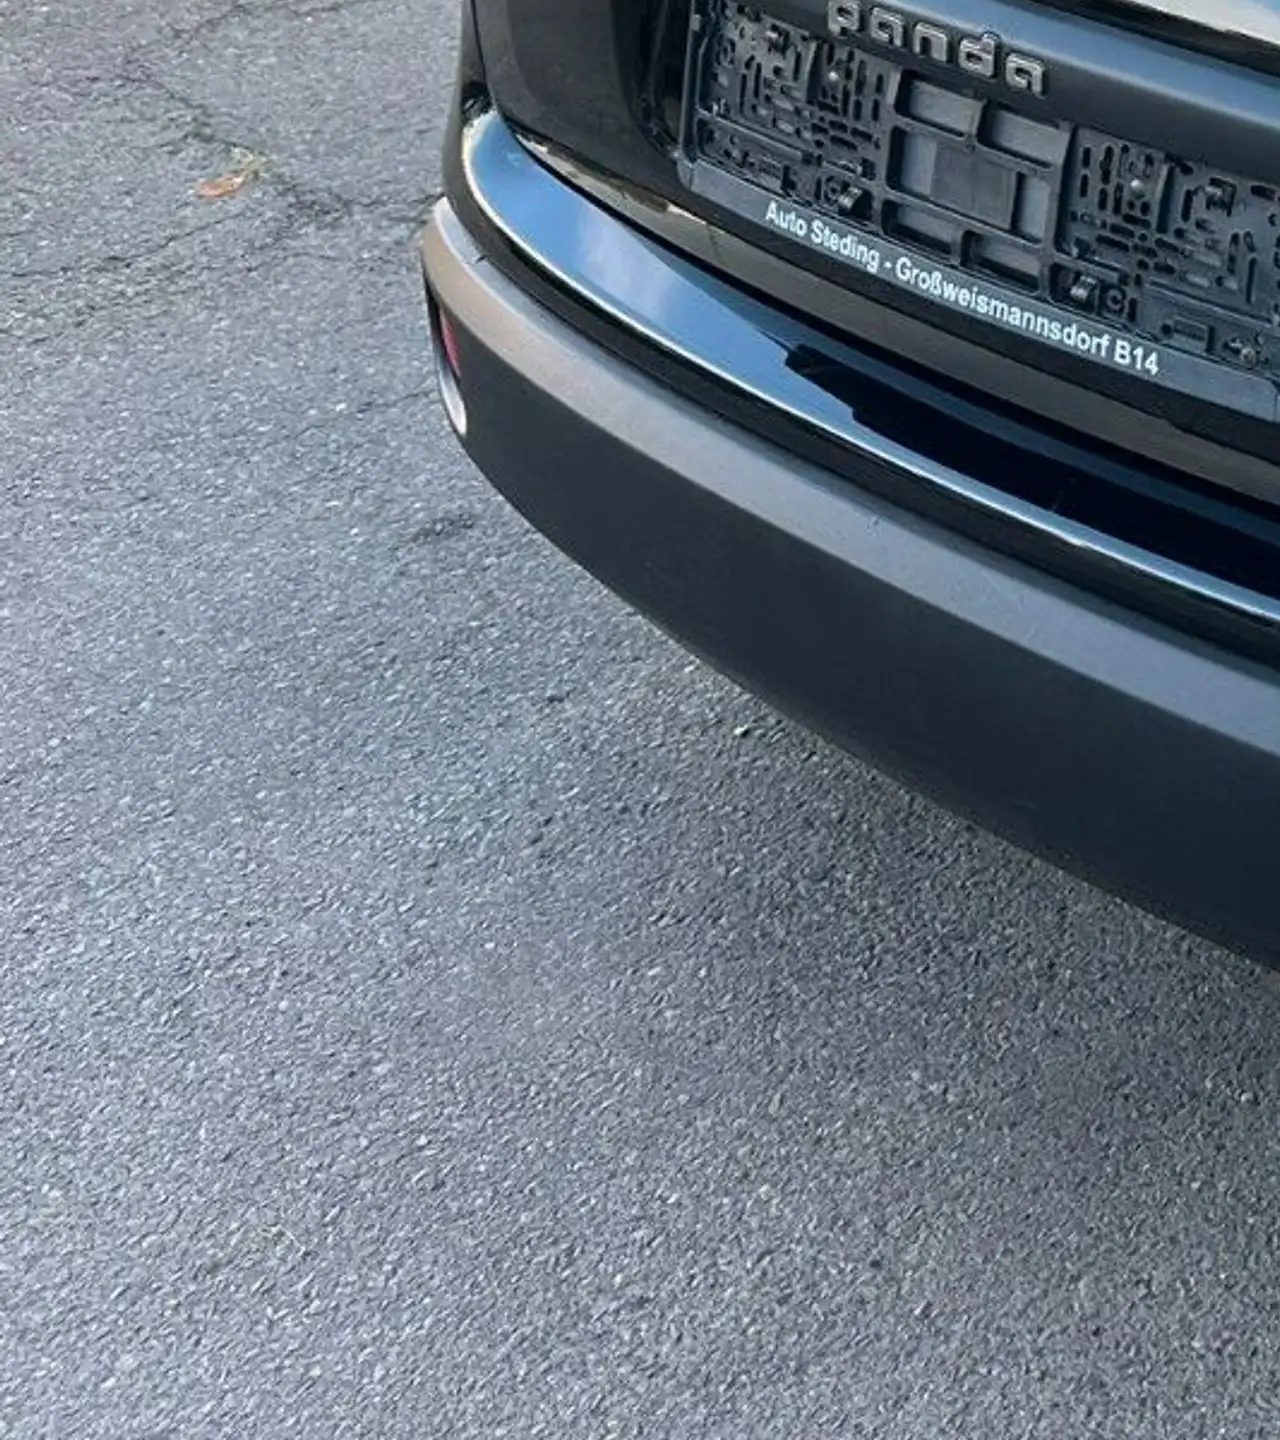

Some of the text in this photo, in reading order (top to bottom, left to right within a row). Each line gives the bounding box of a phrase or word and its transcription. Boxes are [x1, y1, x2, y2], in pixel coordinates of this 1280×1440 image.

[765, 200, 807, 237] Auto
[810, 218, 880, 275] Steding
[895, 256, 1110, 357] Großweismannsdorf
[1113, 339, 1160, 376] B14
